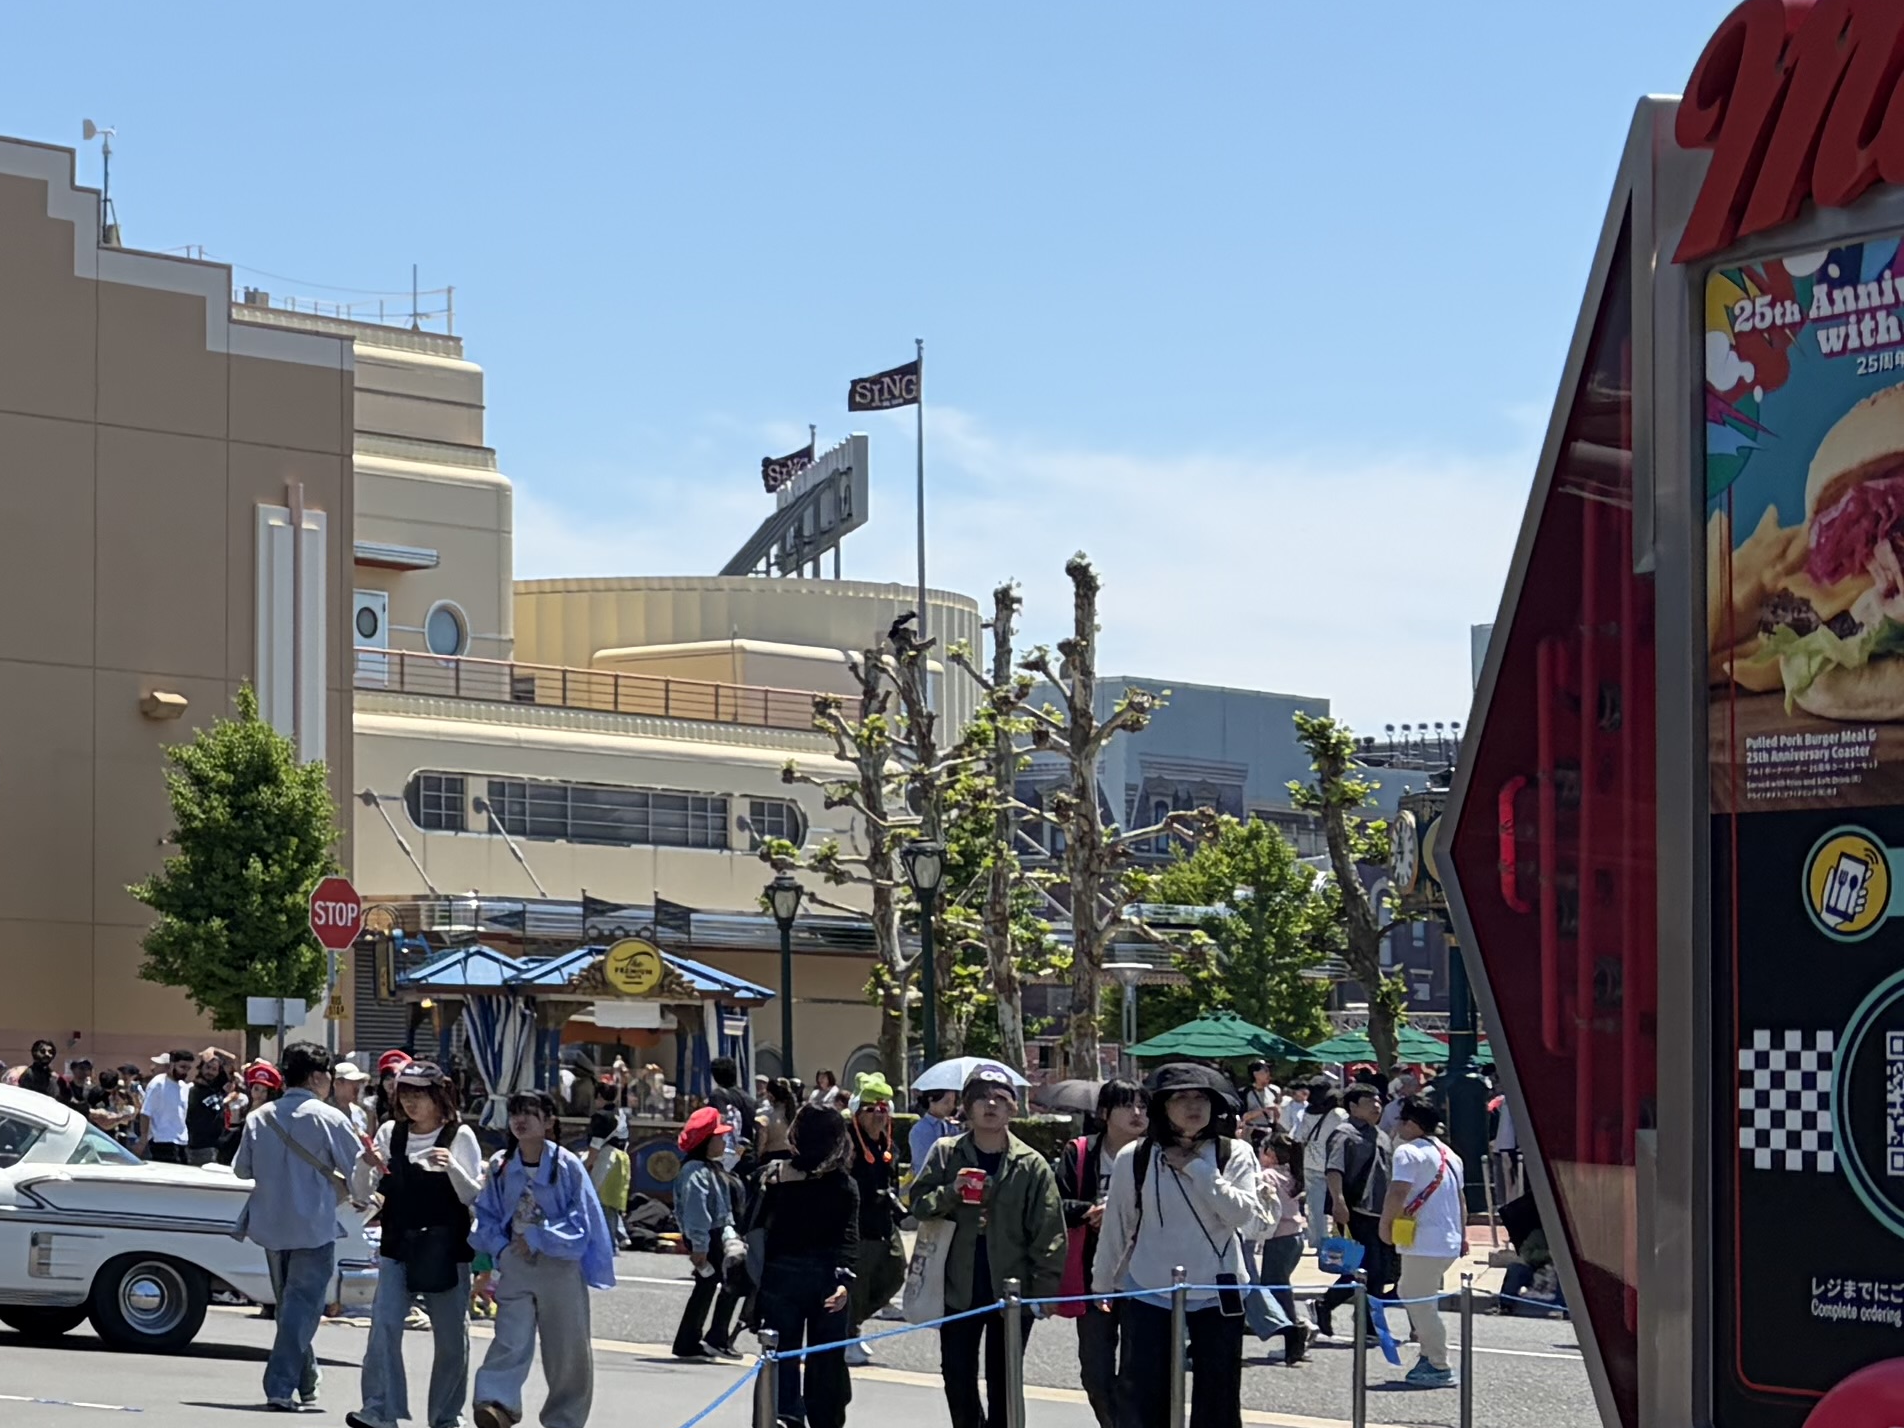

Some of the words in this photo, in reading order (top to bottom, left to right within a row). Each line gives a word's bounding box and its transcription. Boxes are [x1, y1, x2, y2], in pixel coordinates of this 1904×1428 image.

[1734, 295, 1801, 332] 25th
[1816, 310, 1901, 354] with
[855, 374, 917, 406] SING
[1746, 735, 1777, 749] Pulled
[1780, 734, 1803, 747] Pork
[1804, 732, 1839, 747] Burger
[1841, 728, 1867, 742] Meal
[1746, 750, 1769, 764] 25th
[1771, 748, 1829, 762] Anniversary
[1831, 745, 1870, 759] Coaster
[314, 900, 359, 927] STOP
[1811, 1298, 1858, 1322] Complete
[1860, 1304, 1903, 1328] ordering
